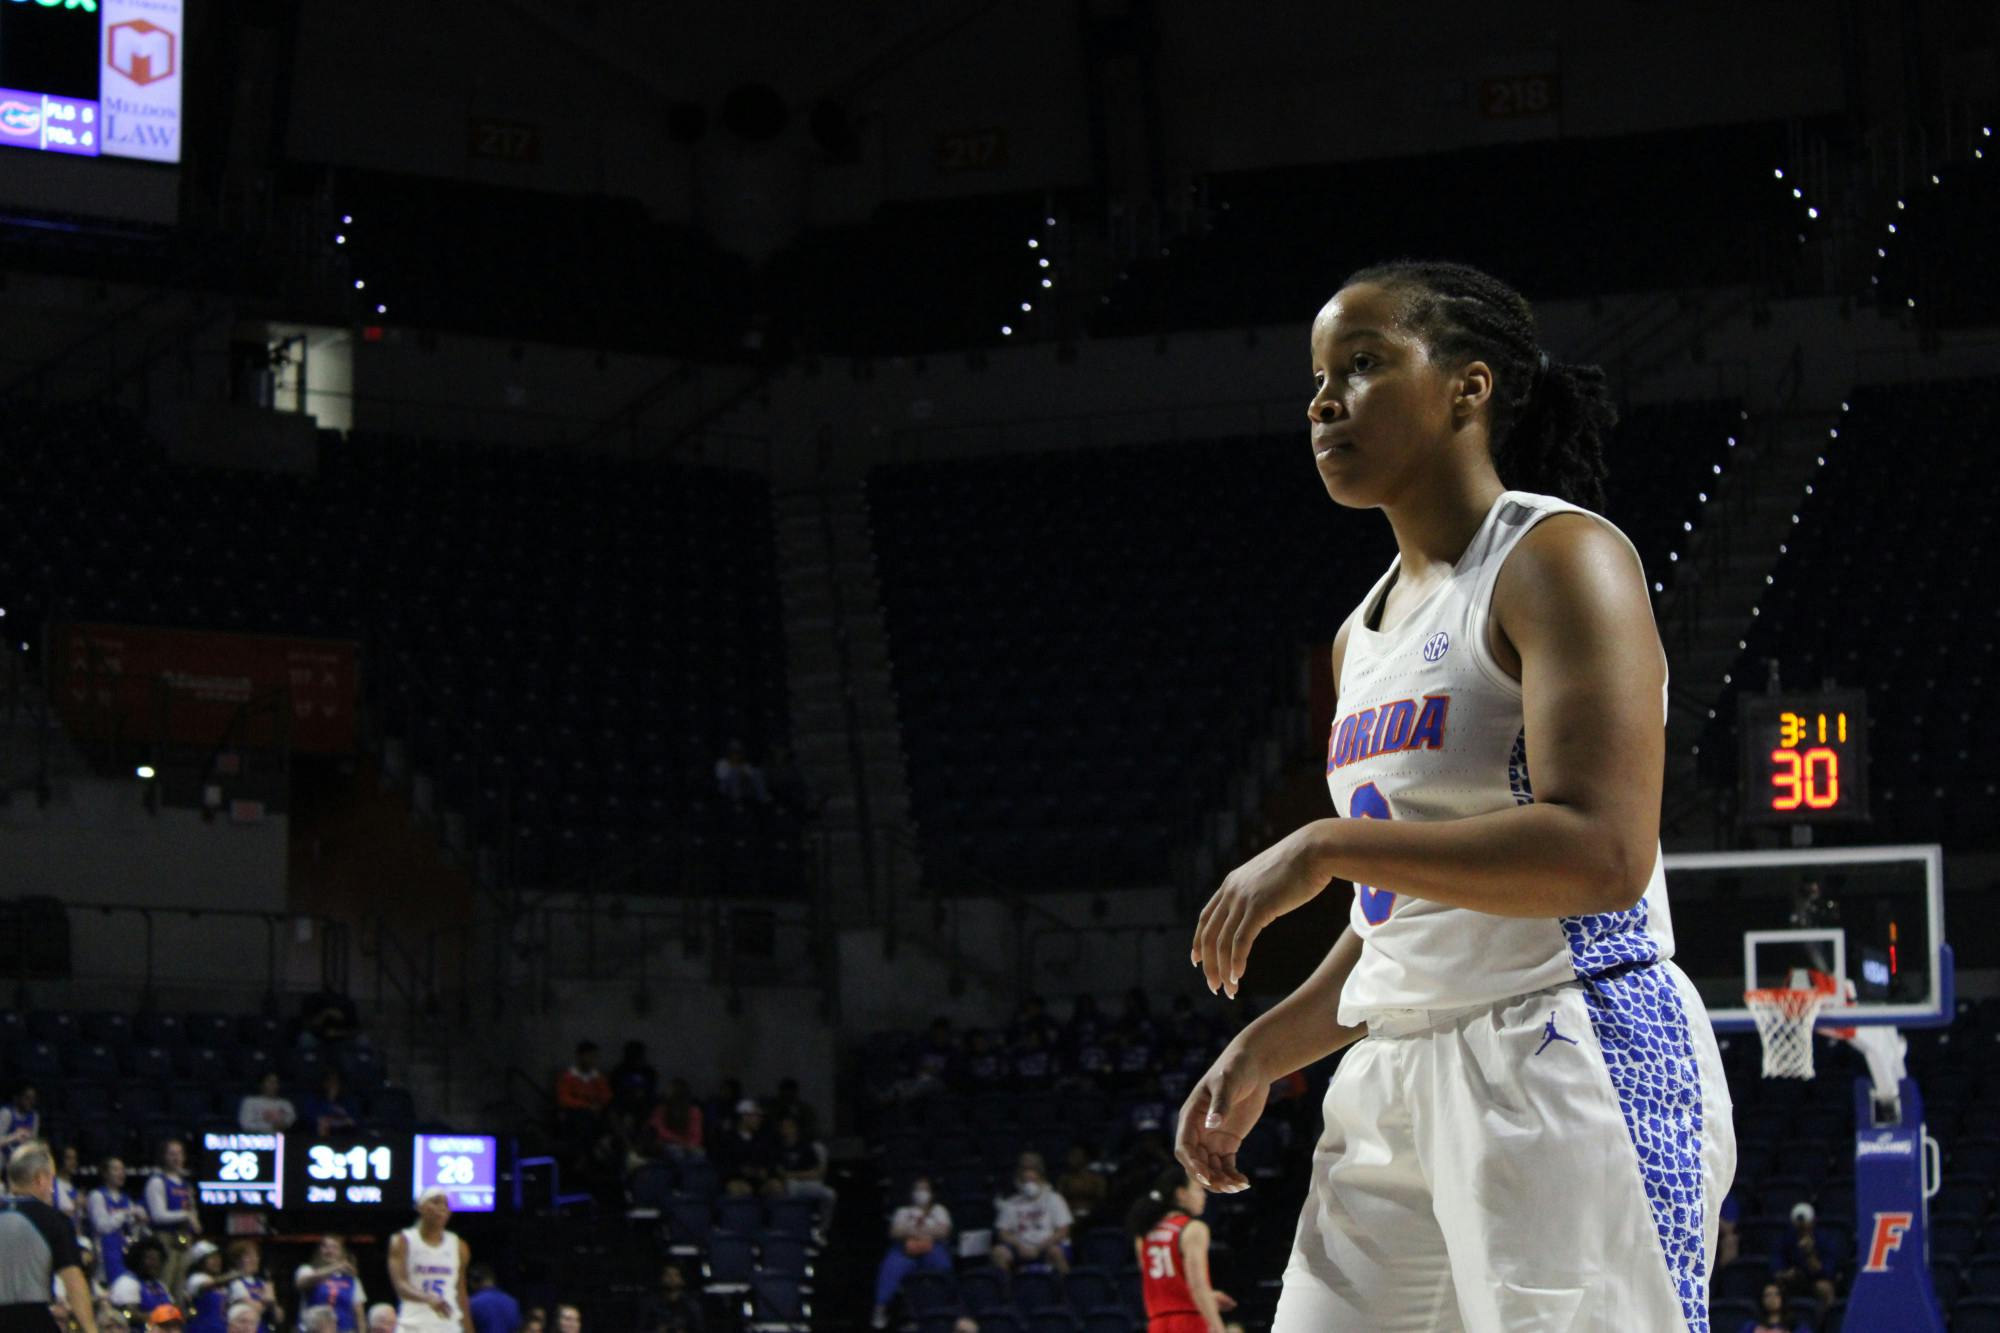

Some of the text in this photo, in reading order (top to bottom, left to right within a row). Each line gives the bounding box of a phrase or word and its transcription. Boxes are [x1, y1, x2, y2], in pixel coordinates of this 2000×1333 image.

[1488, 79, 1549, 114] 218
[478, 123, 532, 157] 217
[943, 133, 997, 168] 217
[1425, 633, 1448, 660] SEC
[1326, 695, 1451, 777] LORIDA
[1780, 712, 1847, 748] 3:11
[1772, 748, 1838, 810] 30
[219, 1151, 259, 1180] 26
[308, 1145, 391, 1180] 3:11
[436, 1155, 474, 1184] 28
[1862, 1212, 1914, 1273] F
[1147, 1245, 1176, 1279] 31
